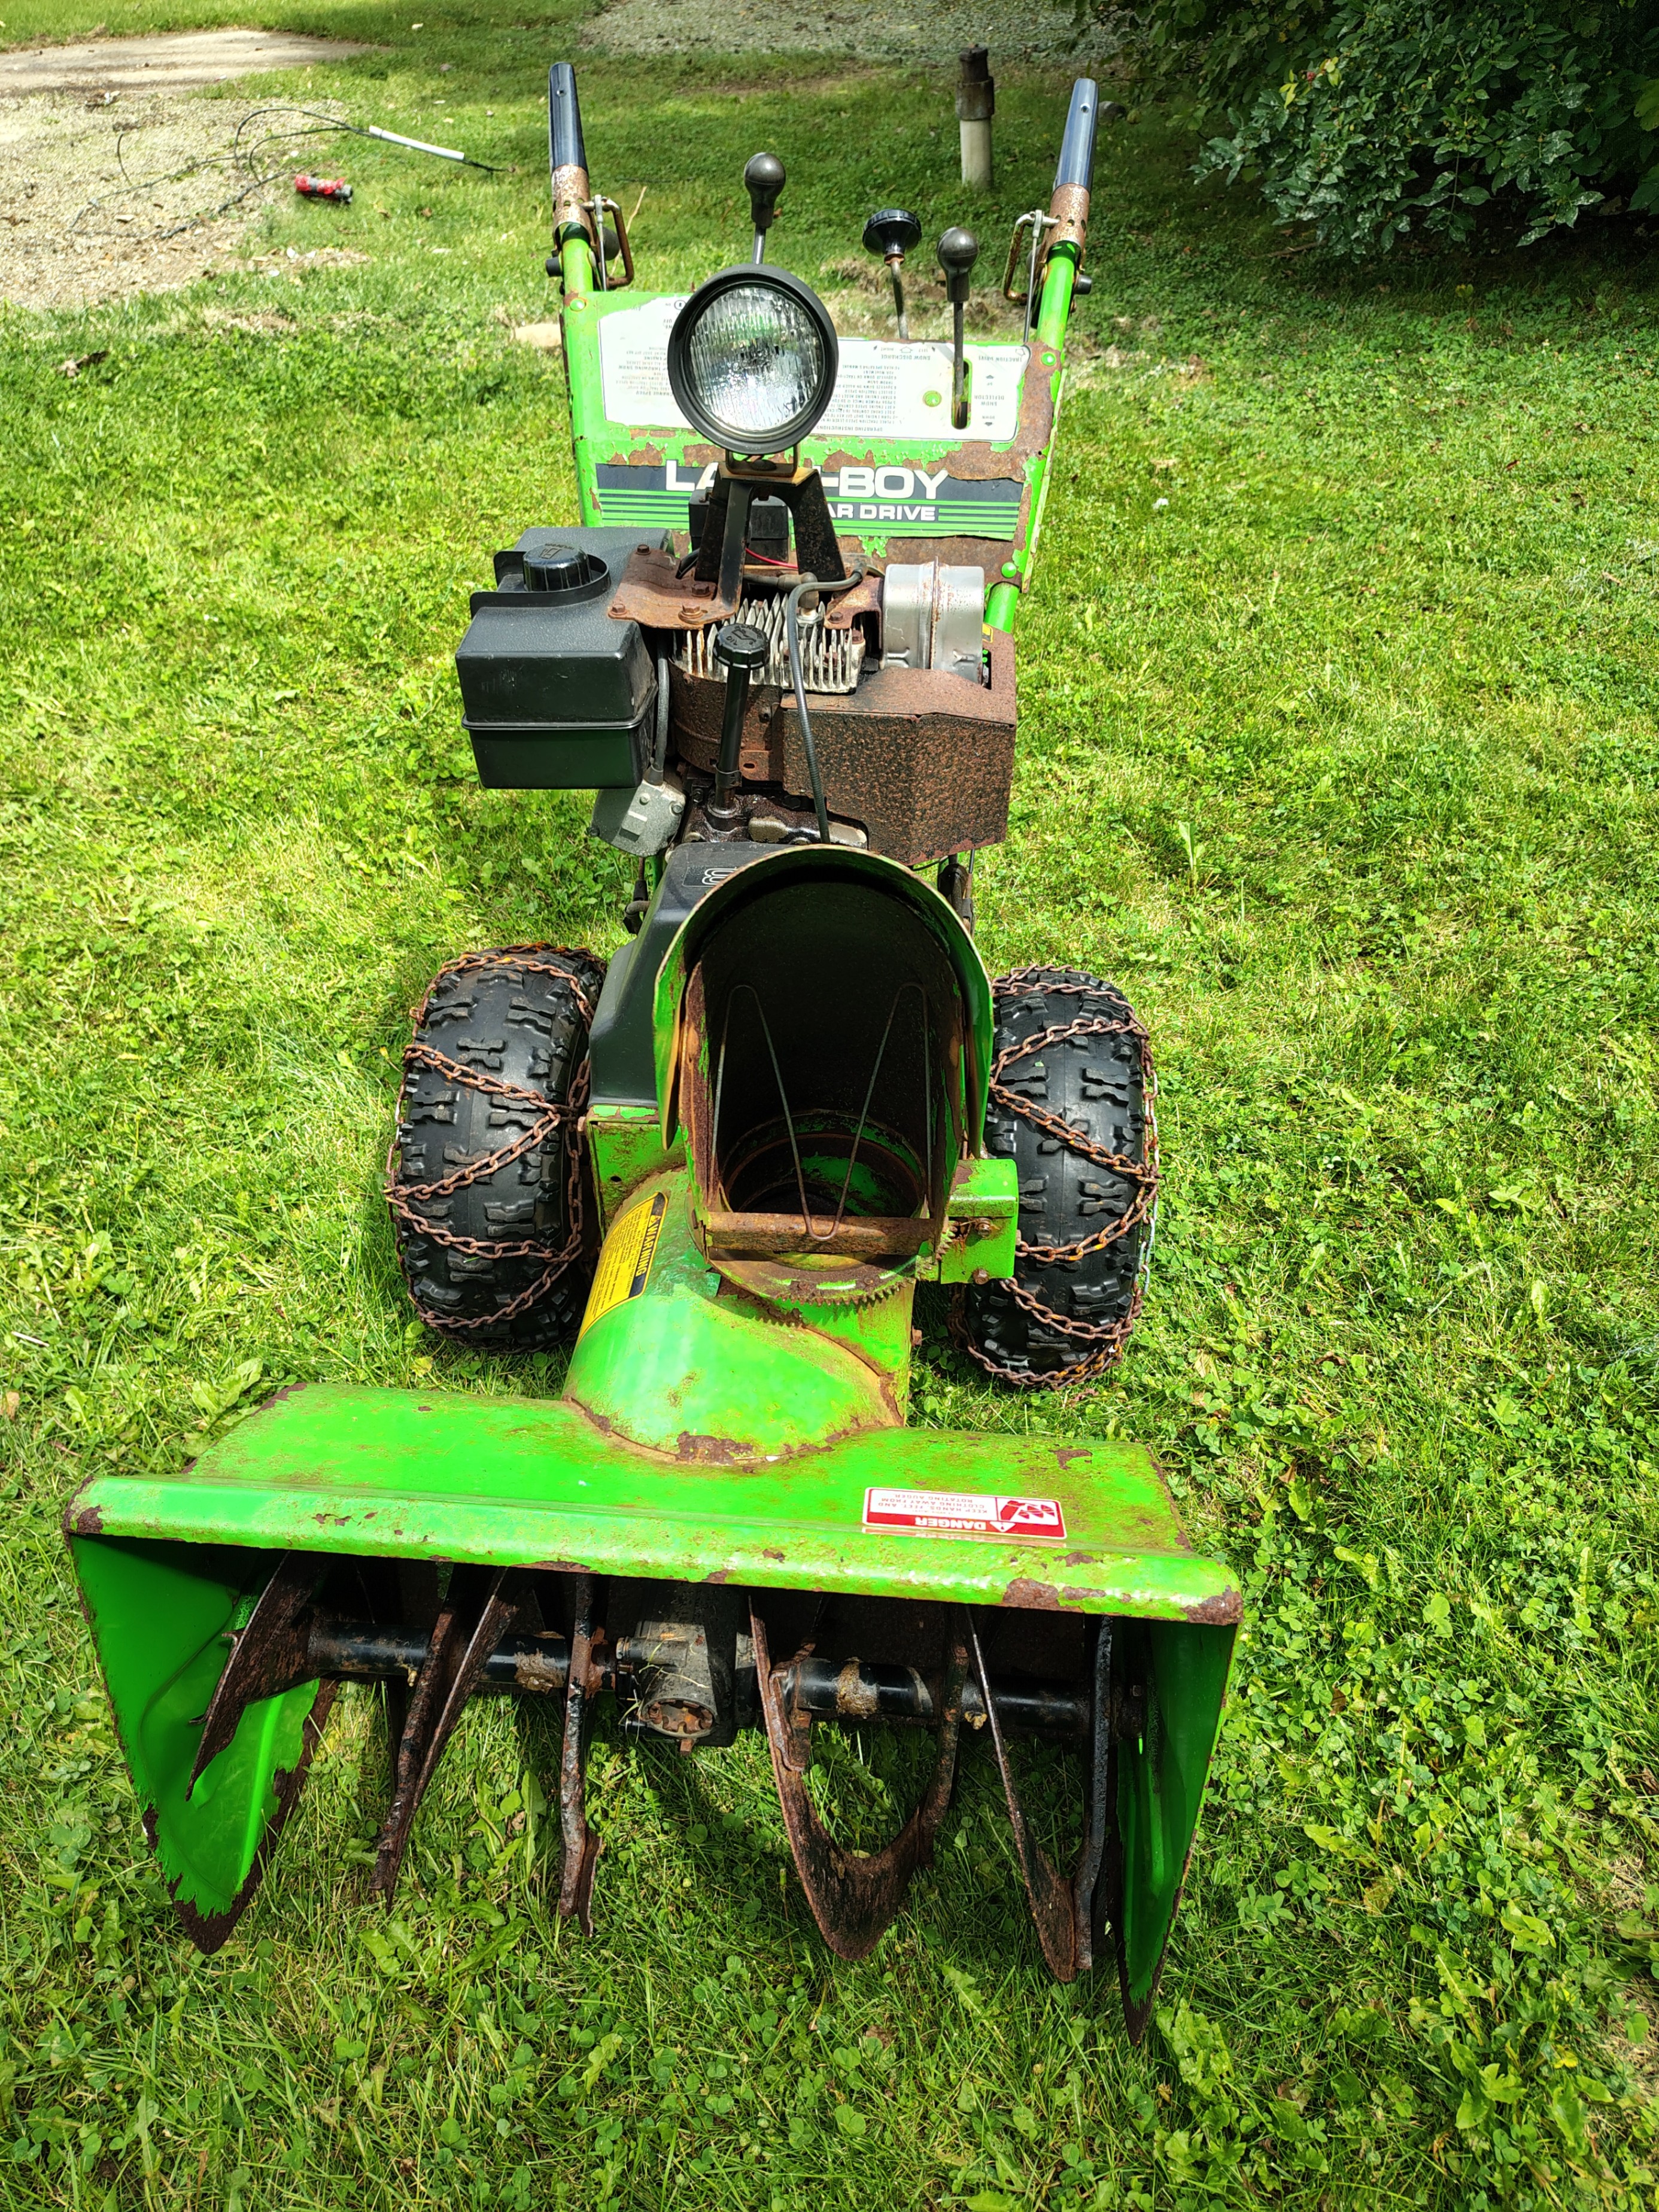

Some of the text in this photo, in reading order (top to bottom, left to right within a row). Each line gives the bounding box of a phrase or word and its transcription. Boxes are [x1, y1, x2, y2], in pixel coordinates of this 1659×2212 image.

[859, 503, 935, 521] DRIVE
[635, 1225, 658, 1277] WARNING
[915, 1517, 986, 1530] DANGER
